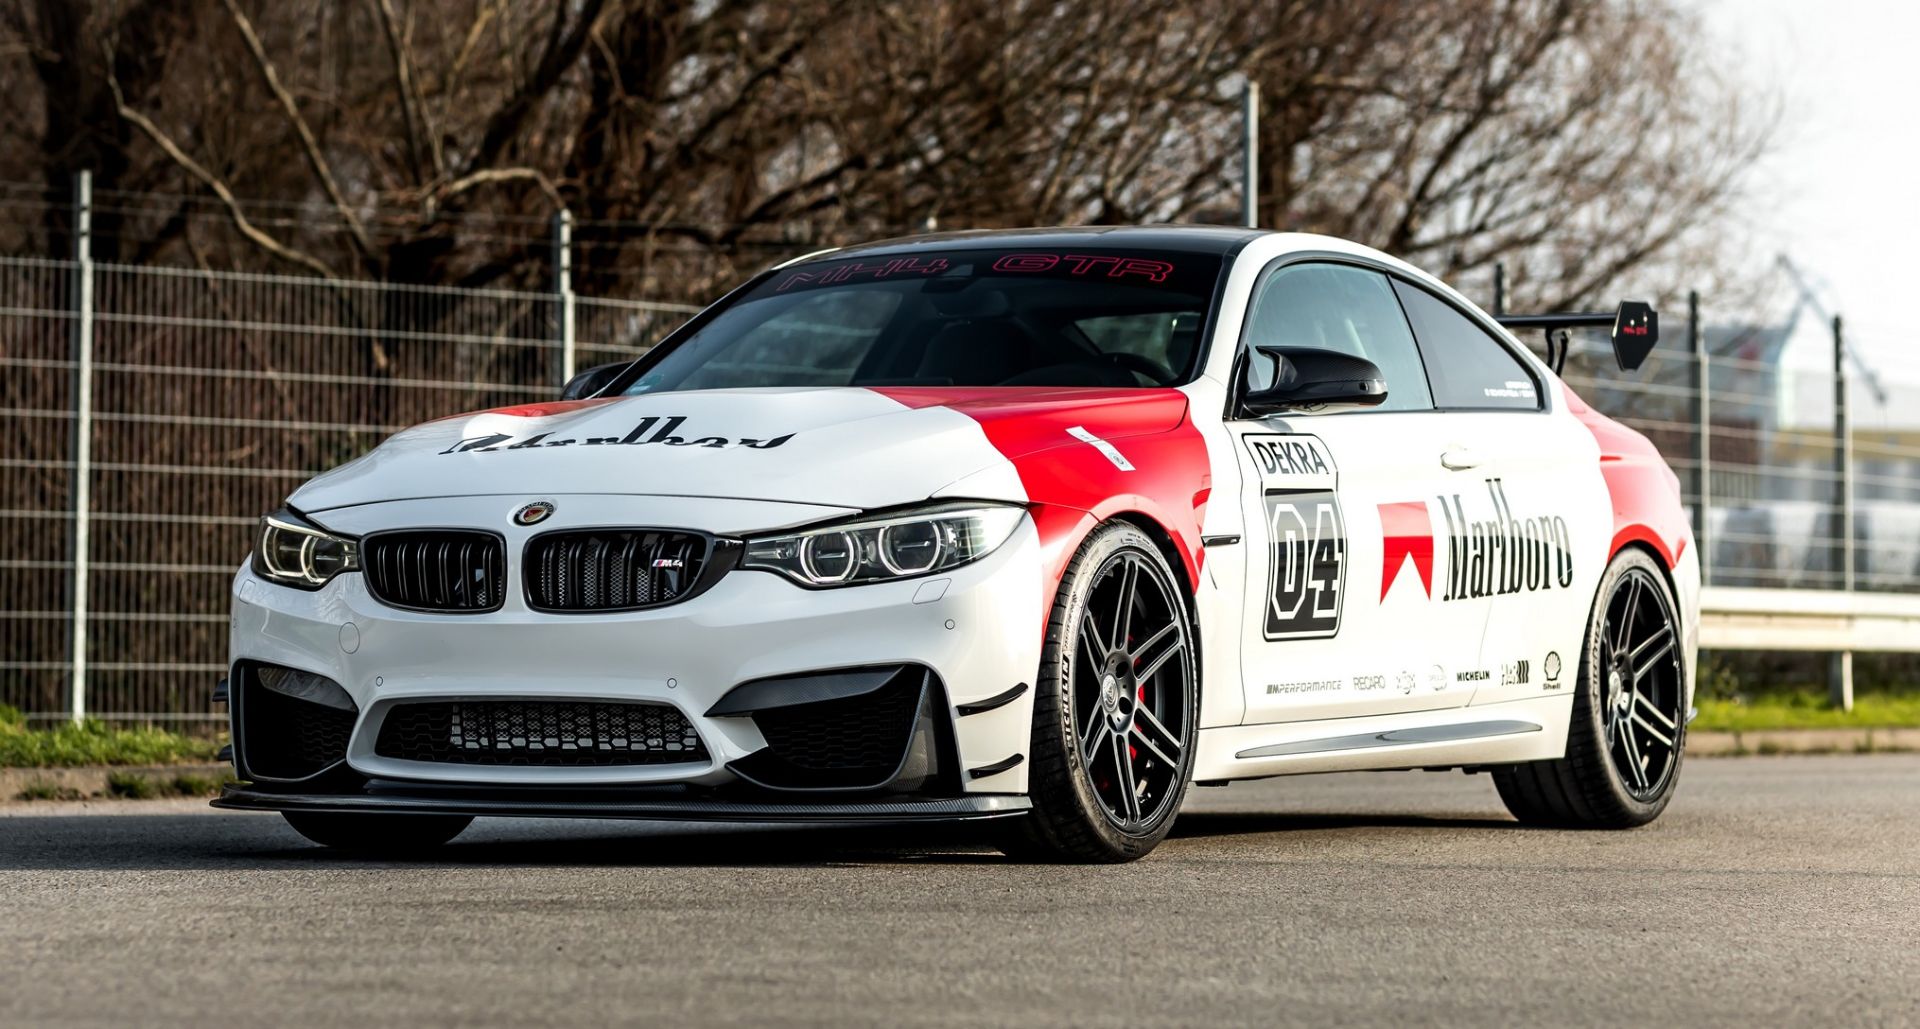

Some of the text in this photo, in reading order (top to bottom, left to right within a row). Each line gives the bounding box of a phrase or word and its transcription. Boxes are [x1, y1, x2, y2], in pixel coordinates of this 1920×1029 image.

[776, 254, 1174, 291] MH4 GTR
[1253, 441, 1331, 475] DEKRA
[1436, 477, 1574, 602] Marlboro
[1272, 503, 1343, 620] 04
[1353, 675, 1386, 690] RECARO
[1456, 670, 1490, 682] MICHELIN
[1062, 660, 1074, 749] MICHELIN
